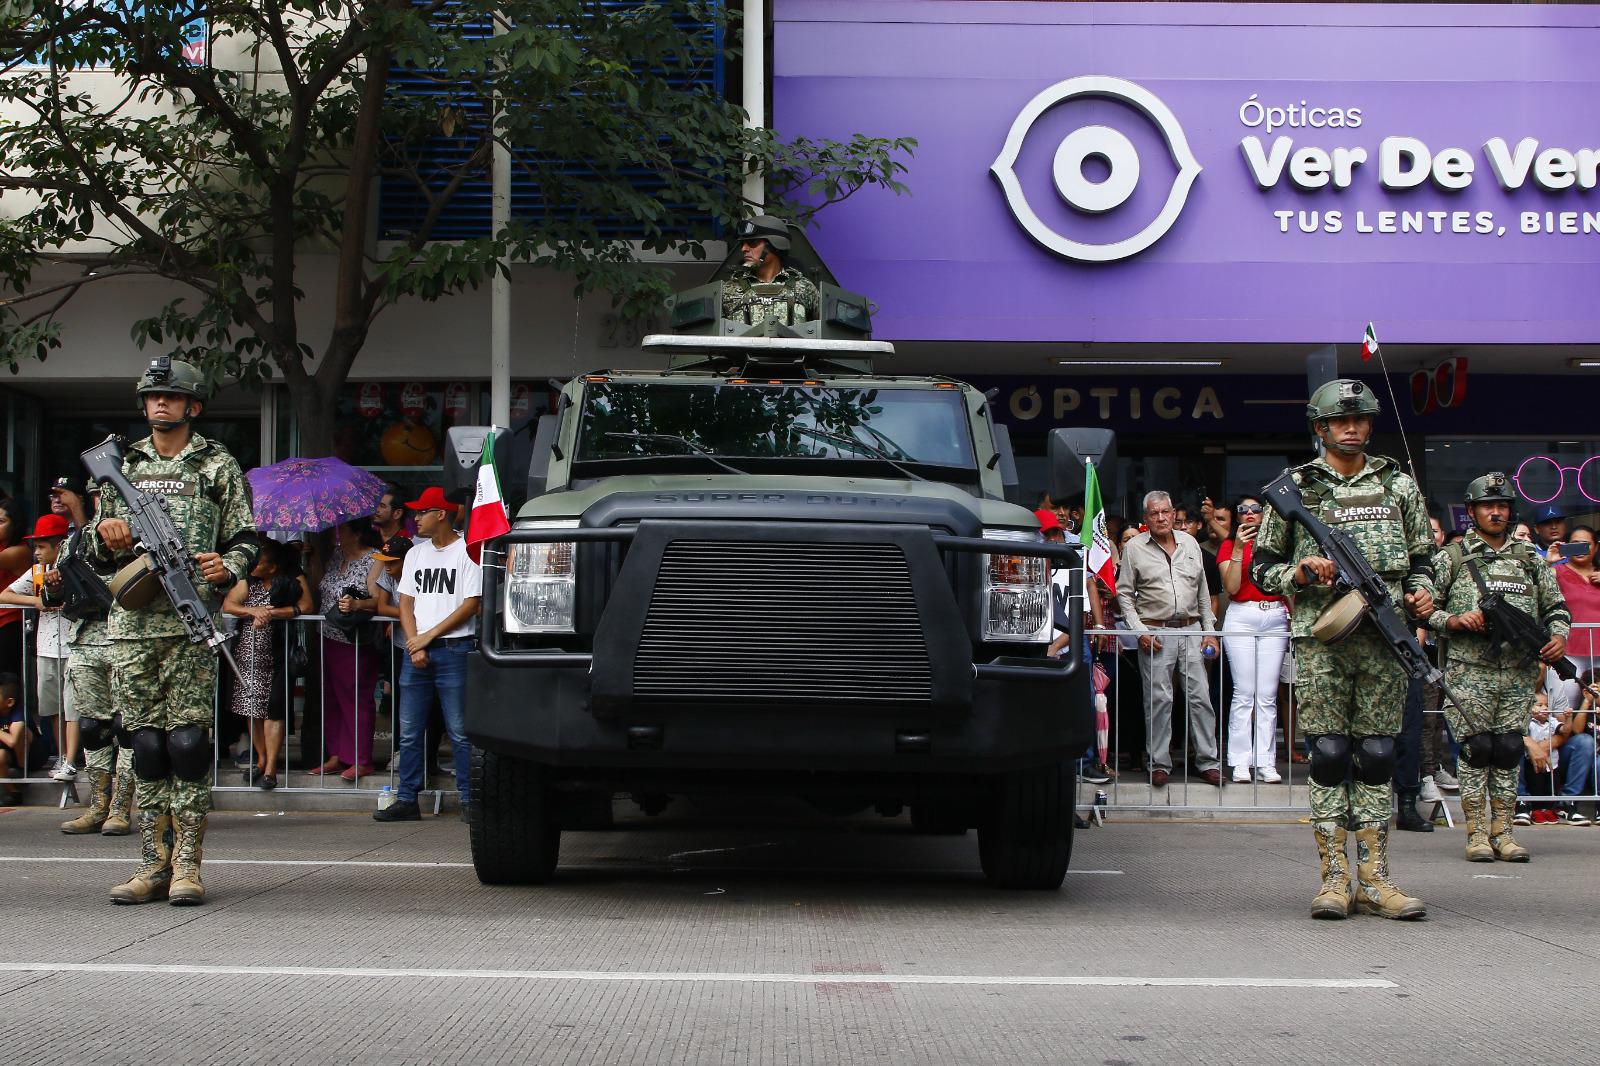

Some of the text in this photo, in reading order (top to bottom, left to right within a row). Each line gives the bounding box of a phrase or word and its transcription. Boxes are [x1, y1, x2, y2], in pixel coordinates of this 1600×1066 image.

[1239, 93, 1363, 134] Ópticas
[1240, 135, 1600, 193] Ver De Ver
[1273, 210, 1600, 237] TUS LENTES, BIEN
[1009, 385, 1225, 420] ÓPTICA
[654, 493, 908, 506] SUPER DUTY
[1334, 506, 1391, 518] EJÉRCITO
[1340, 514, 1388, 522] MEXICANO
[414, 567, 457, 595] SMN
[1485, 580, 1527, 590] EJÉRCITO
